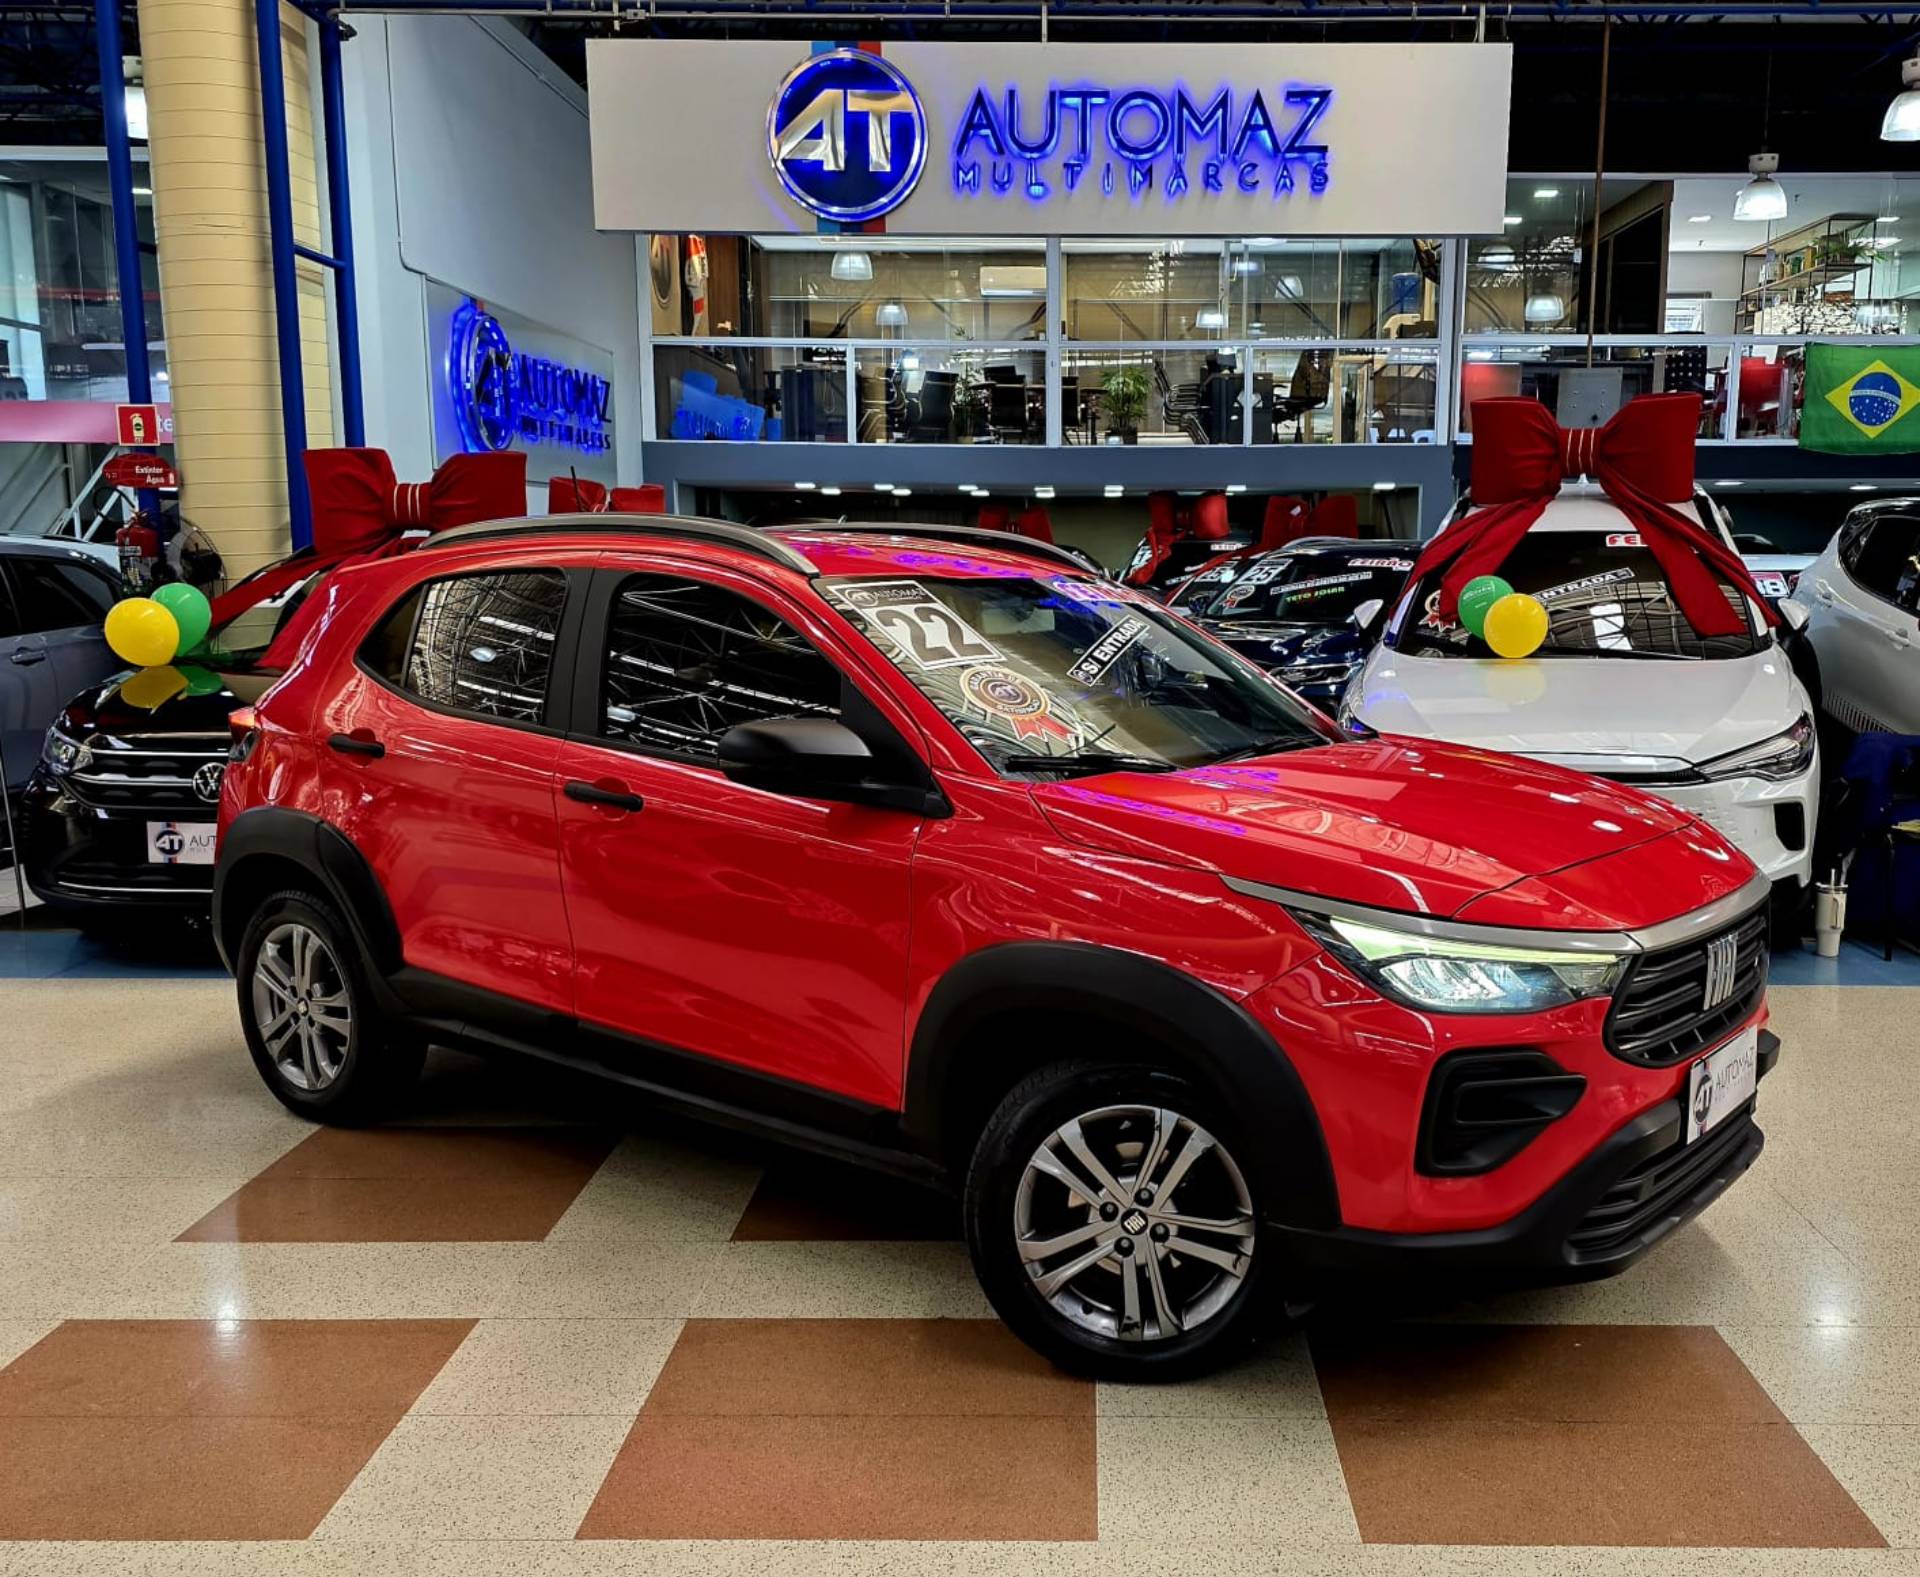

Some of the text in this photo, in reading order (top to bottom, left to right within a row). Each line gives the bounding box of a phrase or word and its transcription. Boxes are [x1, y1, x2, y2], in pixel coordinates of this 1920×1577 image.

[776, 88, 914, 172] AT
[956, 87, 1333, 158] AUTOMAZ
[956, 160, 1330, 196] MULTIMARCAS
[513, 353, 612, 423] AUTOMAZ
[1239, 566, 1275, 582] 25
[875, 606, 990, 660] 22
[1092, 619, 1146, 662] ENTRADA
[155, 835, 217, 850] AT AUT
